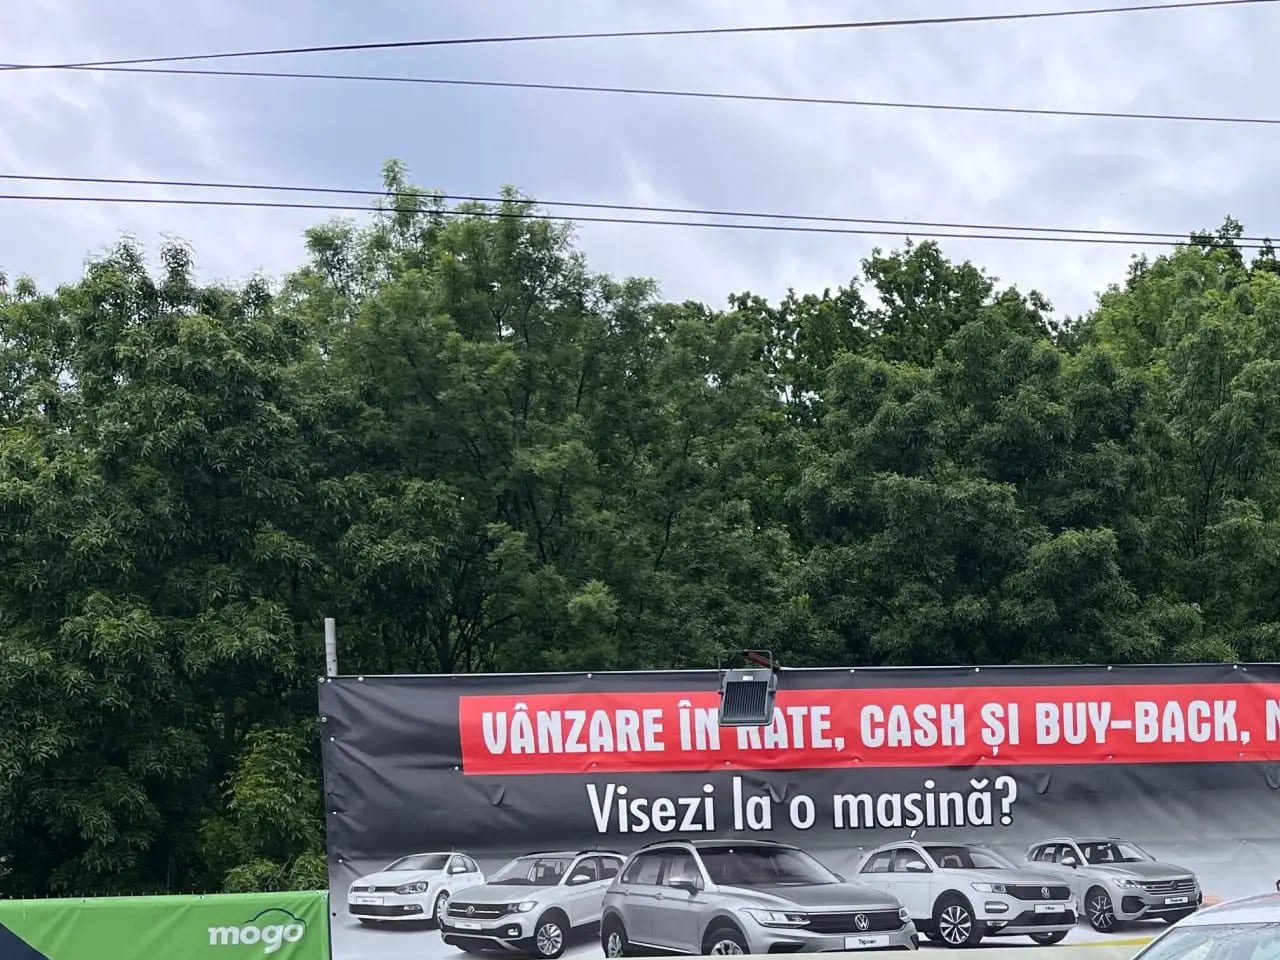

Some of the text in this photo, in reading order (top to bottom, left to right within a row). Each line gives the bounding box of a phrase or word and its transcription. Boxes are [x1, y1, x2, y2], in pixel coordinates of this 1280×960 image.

[482, 702, 665, 755] VÂNZARE
[677, 699, 721, 751] ÎN
[860, 703, 966, 749] CASH
[980, 702, 1020, 757] ȘI
[1035, 700, 1251, 746] BUY-BACK,
[585, 774, 1018, 840] Visezi la o mașină?
[207, 922, 305, 954] mogo
